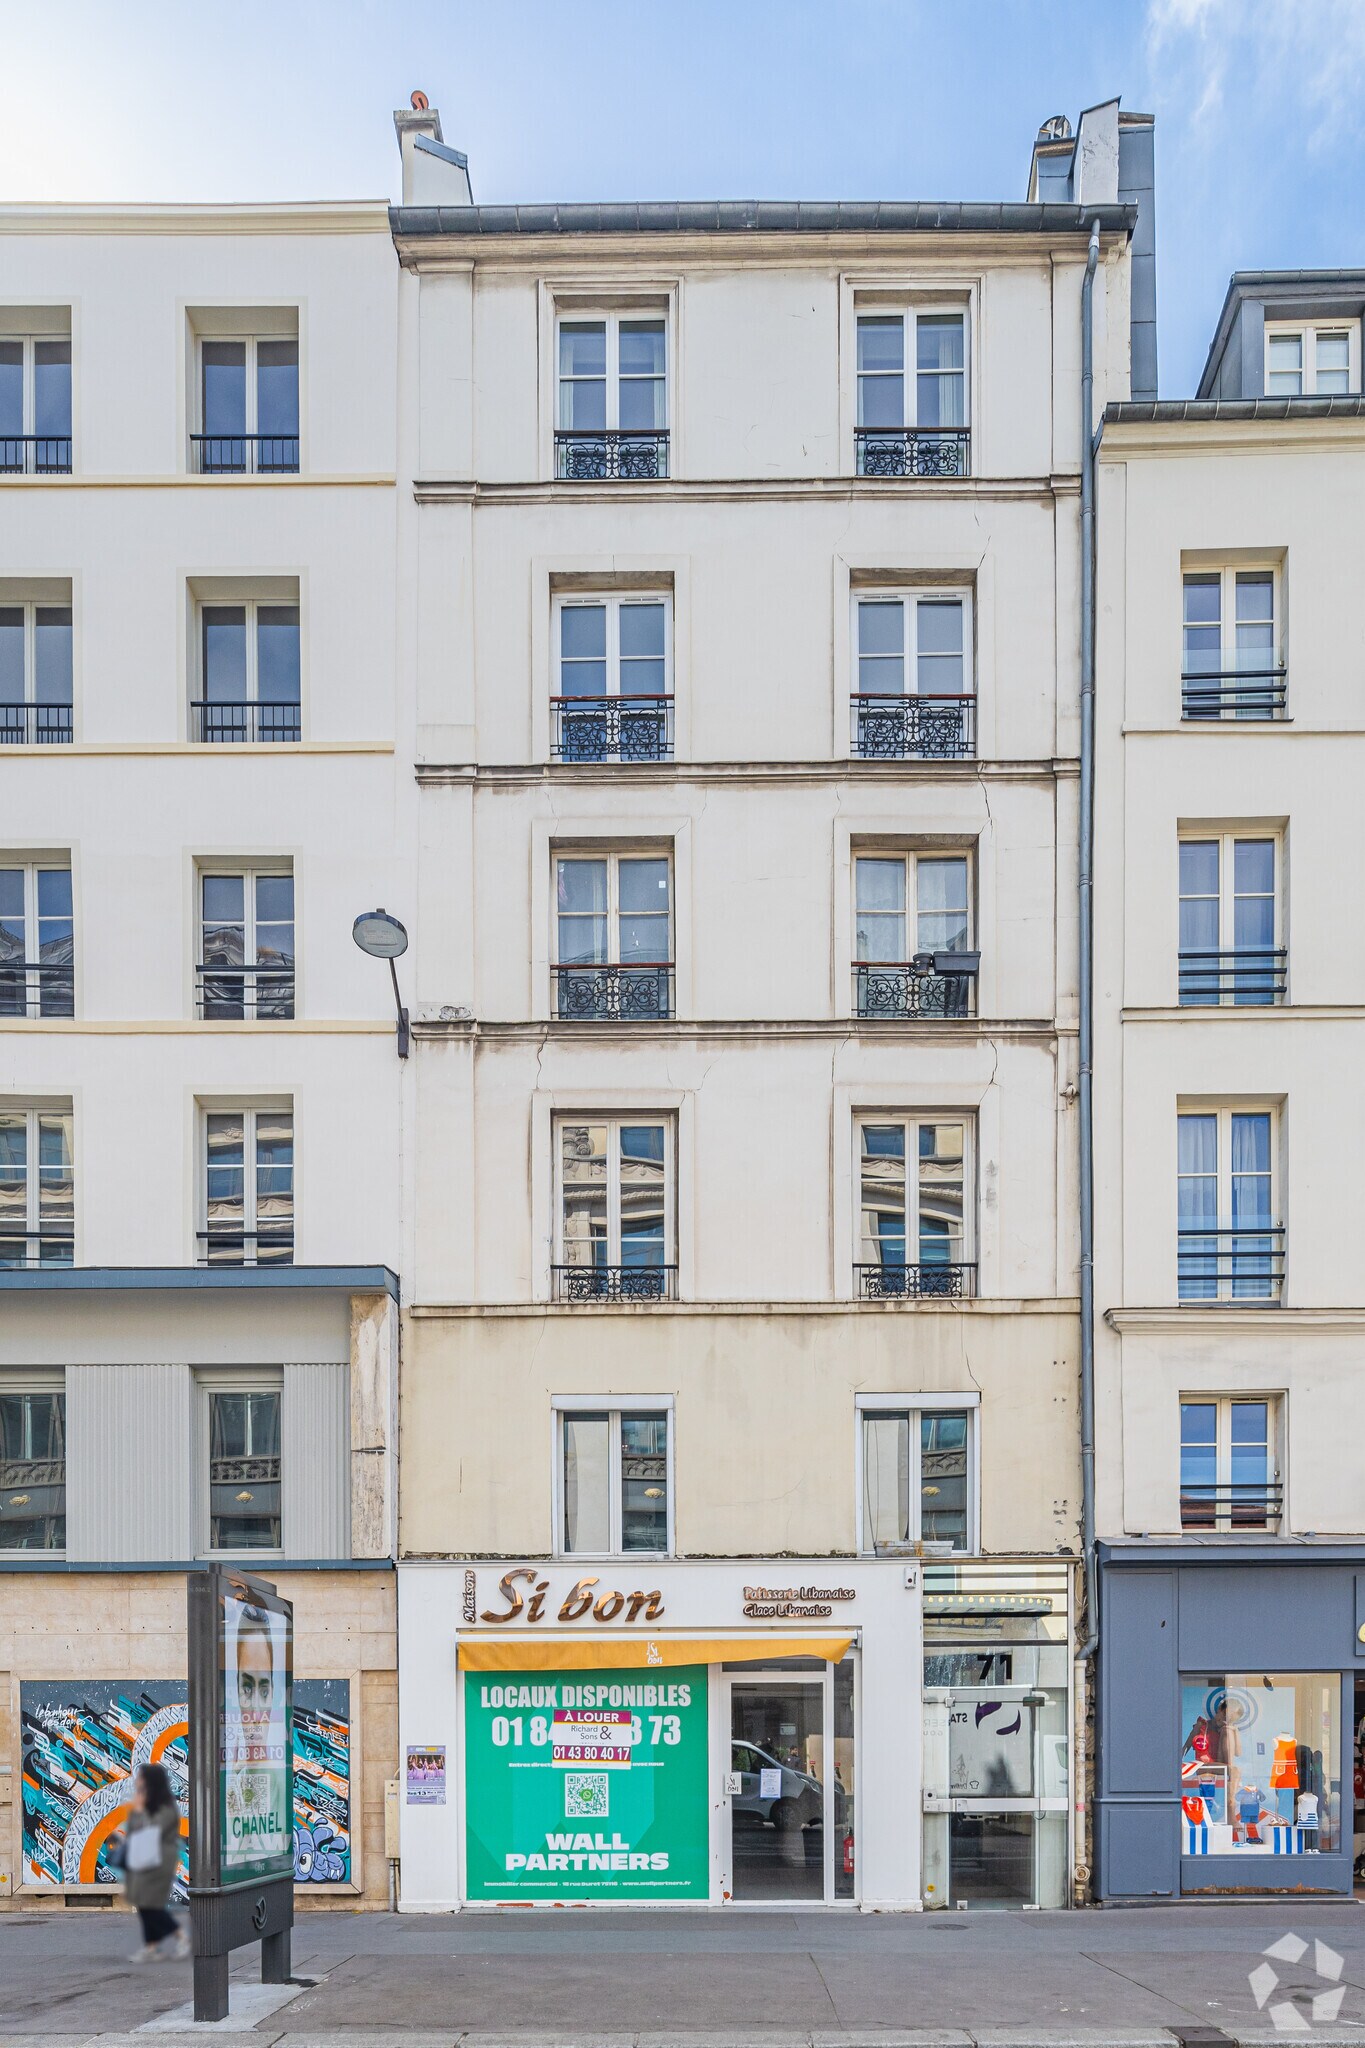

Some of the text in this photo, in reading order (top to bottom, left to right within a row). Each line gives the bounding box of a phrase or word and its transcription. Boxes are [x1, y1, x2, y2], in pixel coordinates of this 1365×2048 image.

[464, 1569, 476, 1624] Maison
[480, 1568, 665, 1623] Si bon
[800, 1586, 856, 1600] Libanaise
[743, 1603, 832, 1617] Glace Libanaise
[977, 1655, 1012, 1680] 71
[481, 1685, 691, 1708] LOCAUX DISPONIBLES
[564, 1710, 619, 1722] À LOUER
[491, 1716, 523, 1746] 01
[648, 1715, 681, 1745] 73
[600, 1726, 612, 1740] &
[553, 1746, 630, 1761] 01 43 80 40 17
[232, 1811, 282, 1839] CHANEL
[545, 1833, 629, 1850] WALL
[506, 1853, 669, 1871] PARTNERS
